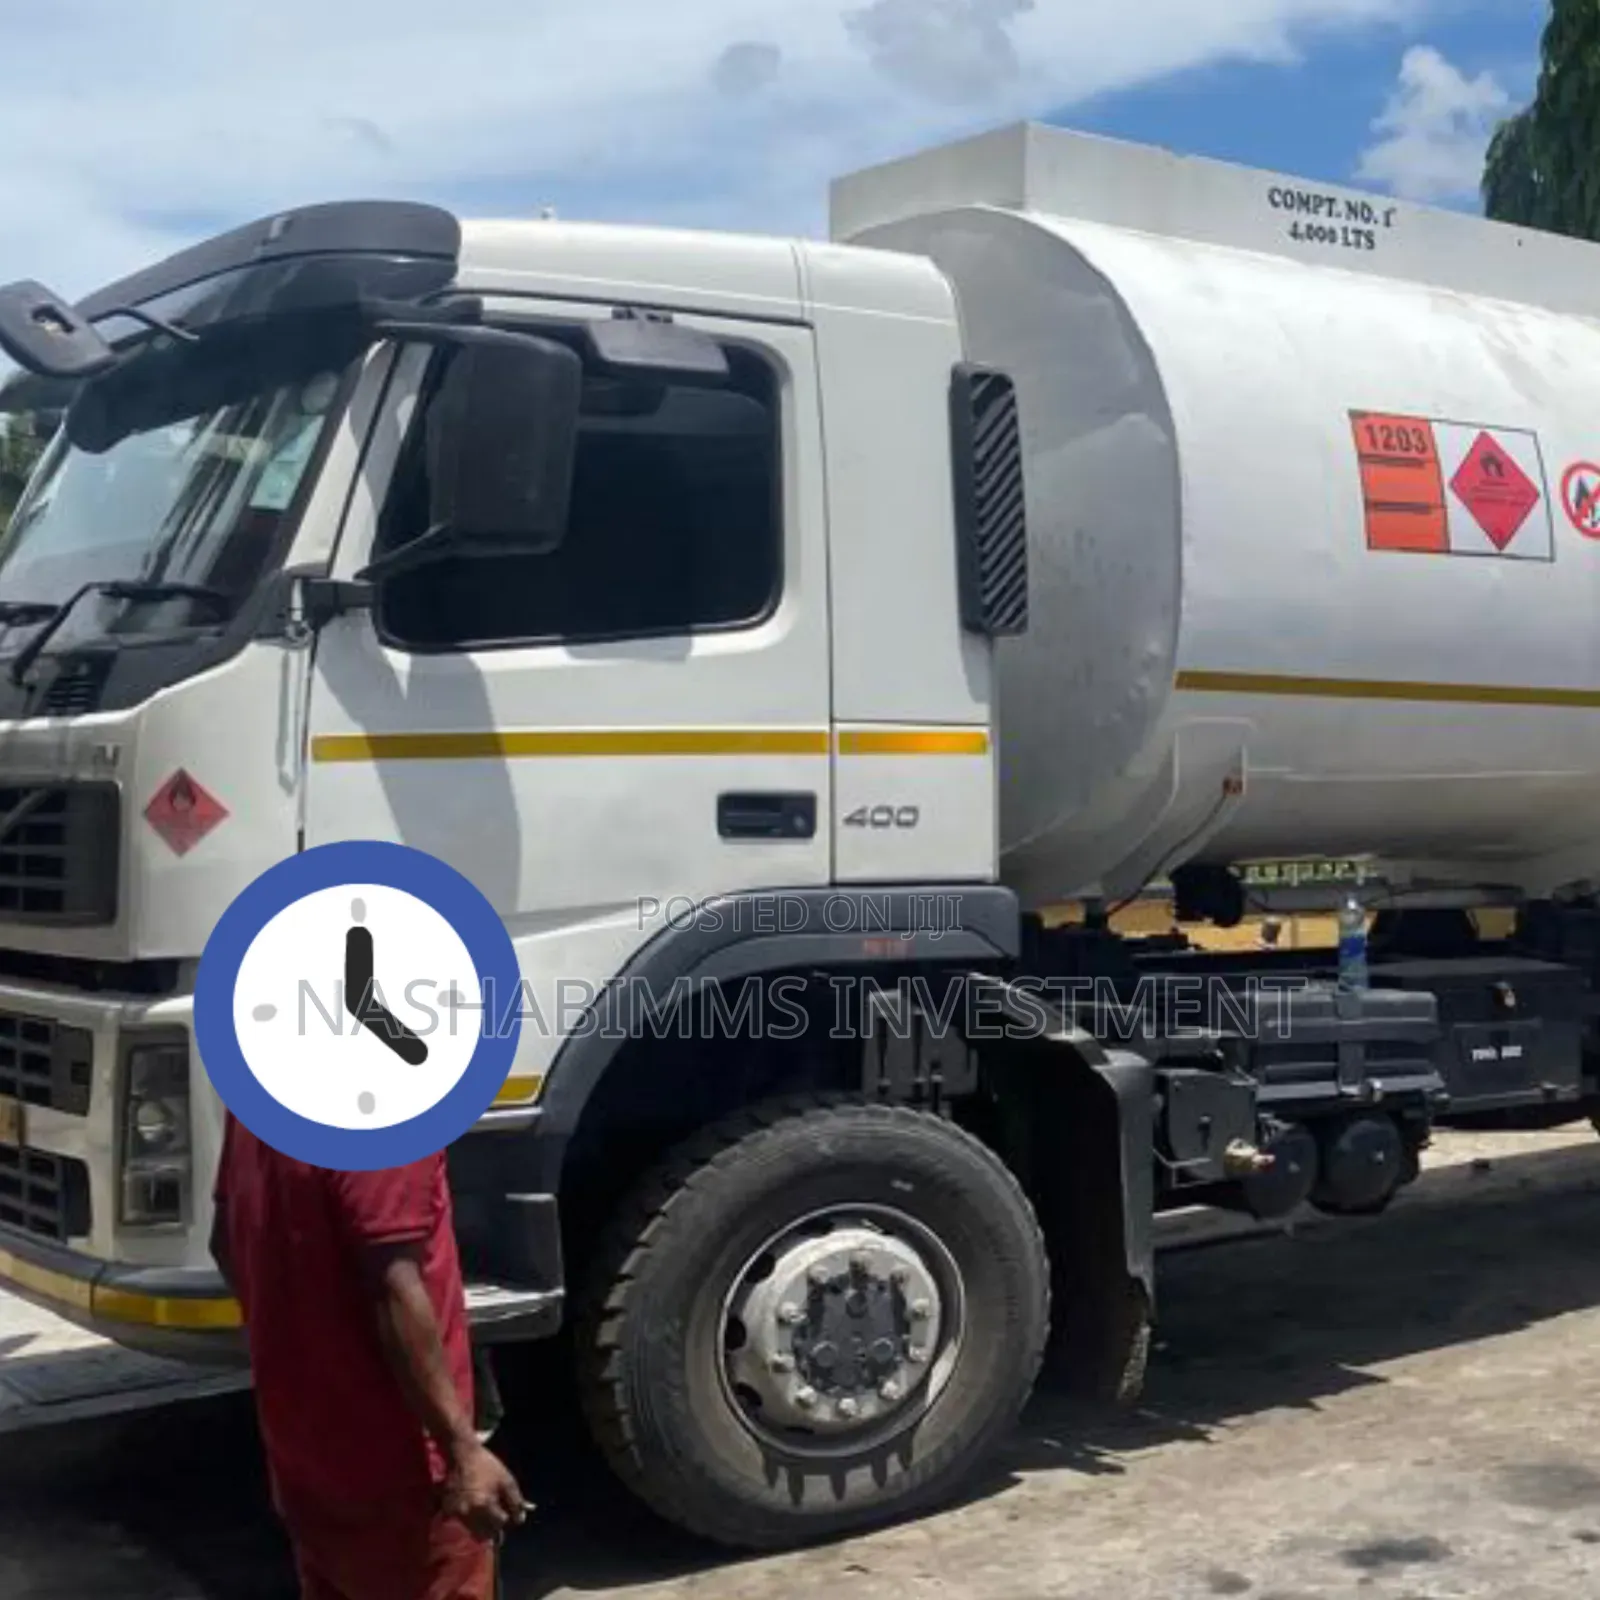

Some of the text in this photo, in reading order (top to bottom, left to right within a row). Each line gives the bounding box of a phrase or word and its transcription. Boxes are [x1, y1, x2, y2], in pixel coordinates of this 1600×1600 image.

[1340, 226, 1375, 251] LTS
[1364, 423, 1429, 454] 1203
[842, 804, 919, 829] 400
